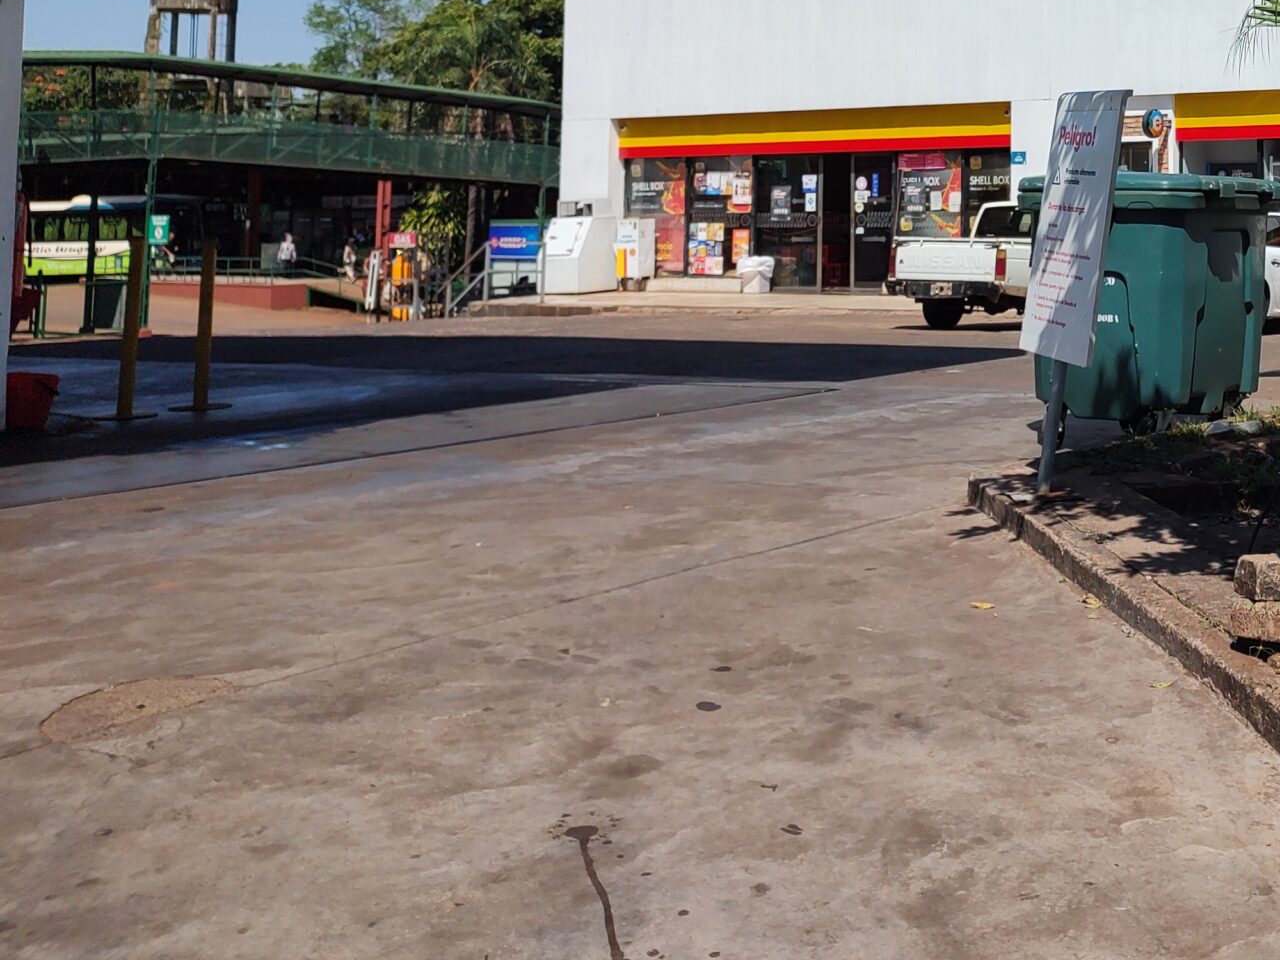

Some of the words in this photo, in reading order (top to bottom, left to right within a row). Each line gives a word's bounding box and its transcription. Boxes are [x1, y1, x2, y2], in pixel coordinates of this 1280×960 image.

[1058, 123, 1097, 153] Peligro!
[970, 175, 992, 186] SHELL
[993, 175, 1010, 185] BOX
[631, 181, 649, 192] SHELL
[650, 181, 665, 191] BOX
